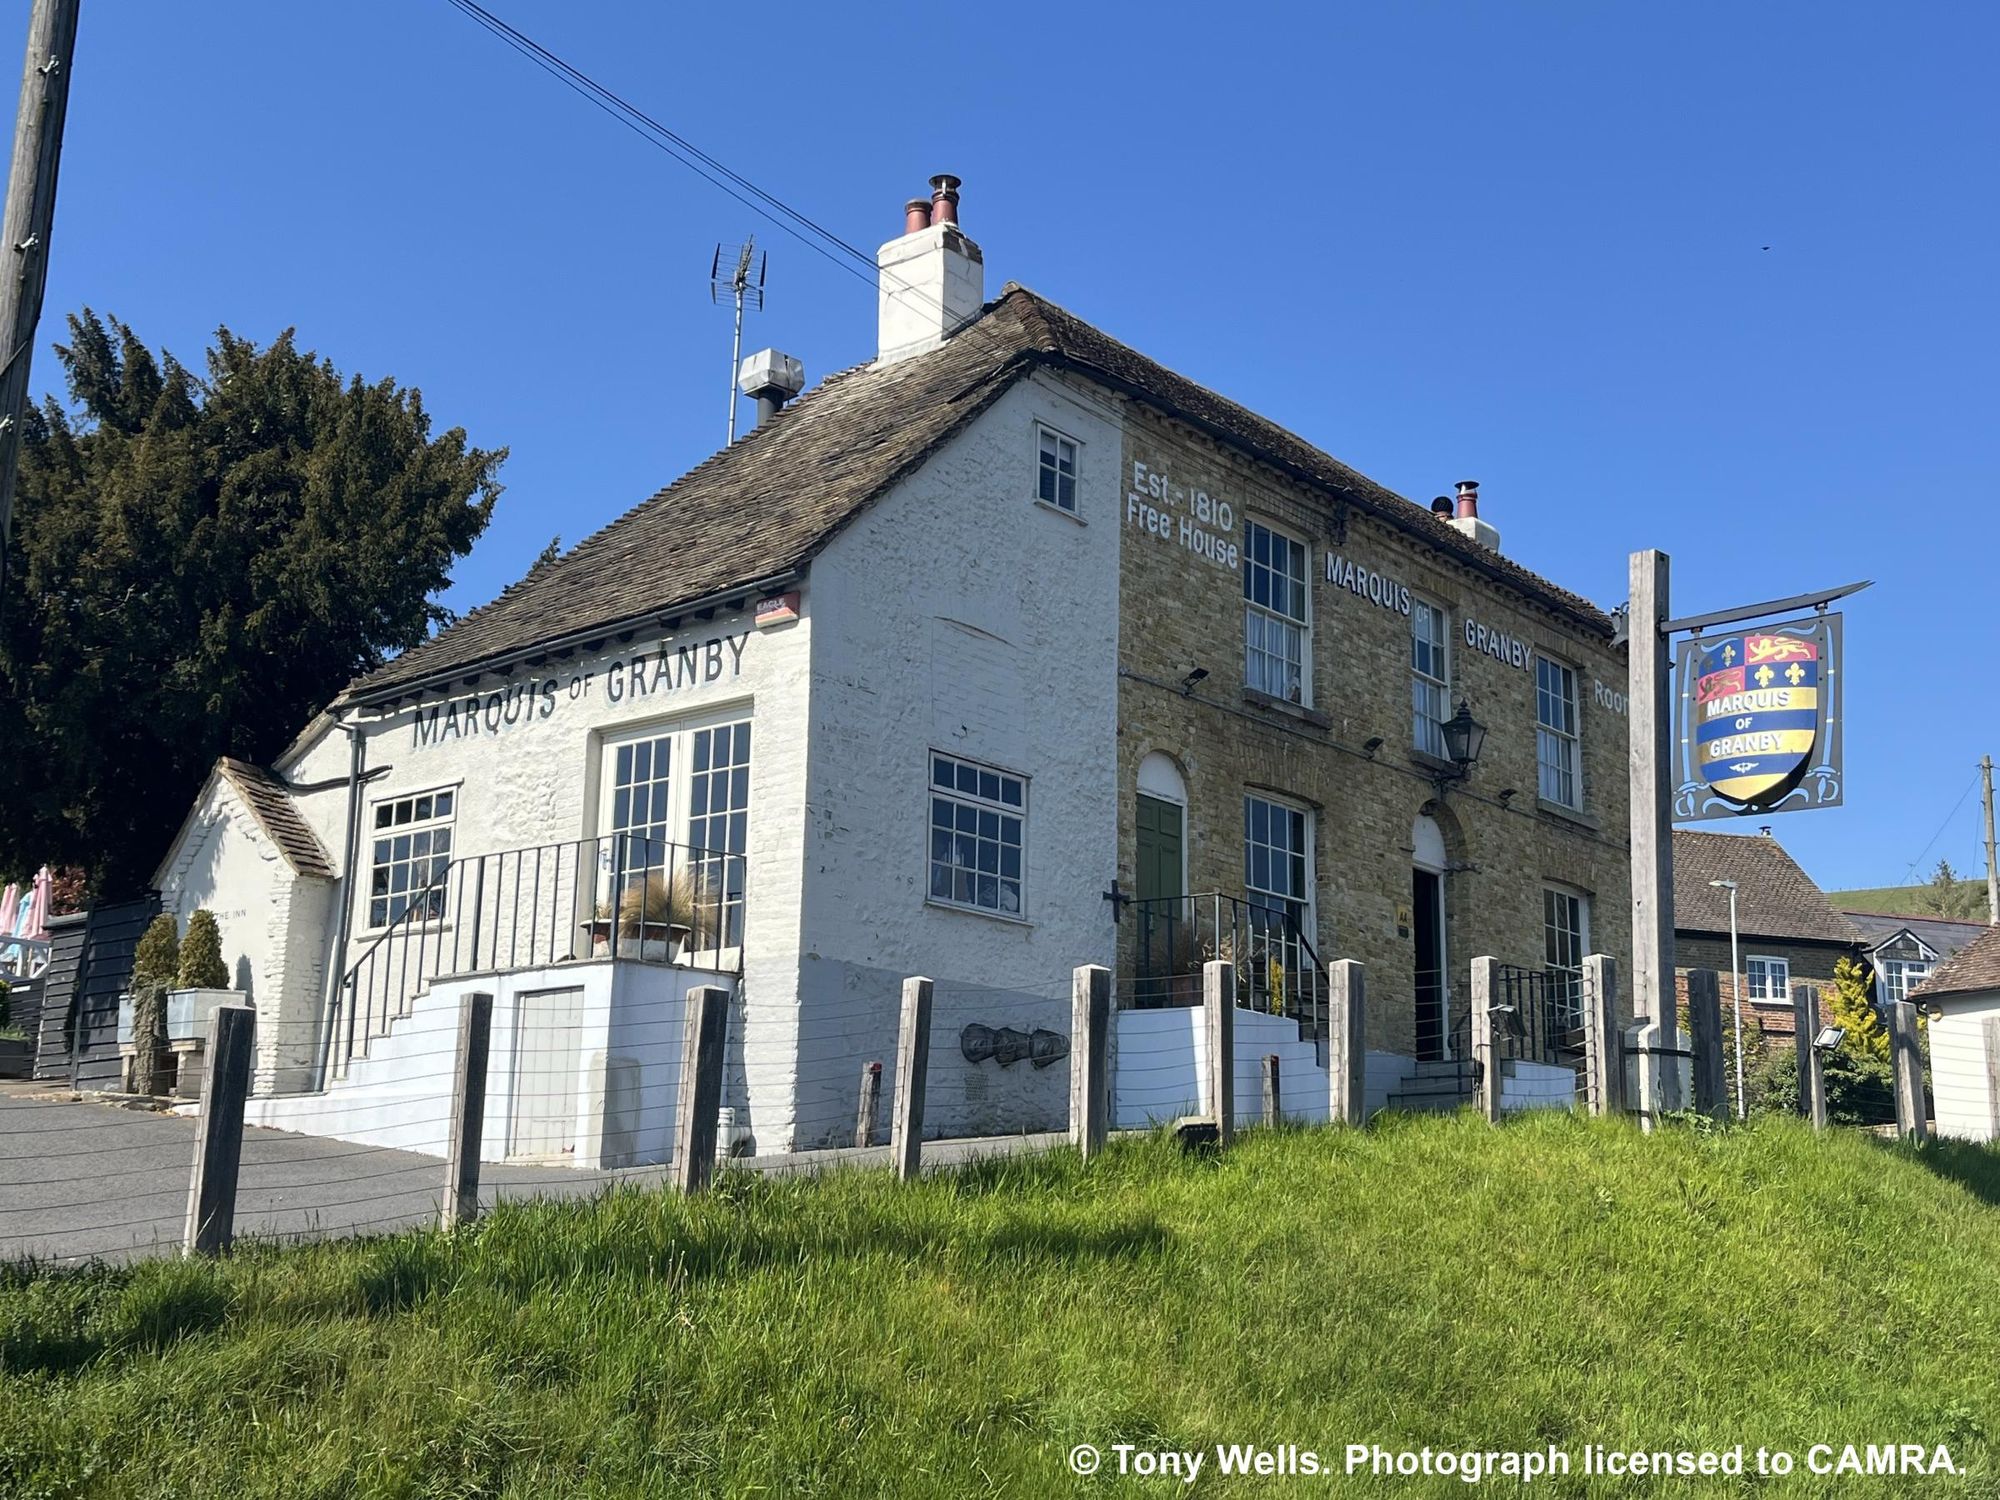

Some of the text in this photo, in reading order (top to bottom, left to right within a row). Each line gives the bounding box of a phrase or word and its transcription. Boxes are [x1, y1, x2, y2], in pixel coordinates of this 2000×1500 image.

[1127, 492, 1238, 569] Free House
[1190, 487, 1233, 531] 1810
[1326, 551, 1532, 671] MARQUIS OF GRANBY
[412, 631, 751, 748] MARQUIS OF GRANBY
[1707, 689, 1790, 718] MARQUIS
[1735, 717, 1753, 730] OF
[1710, 734, 1783, 758] GRANBY
